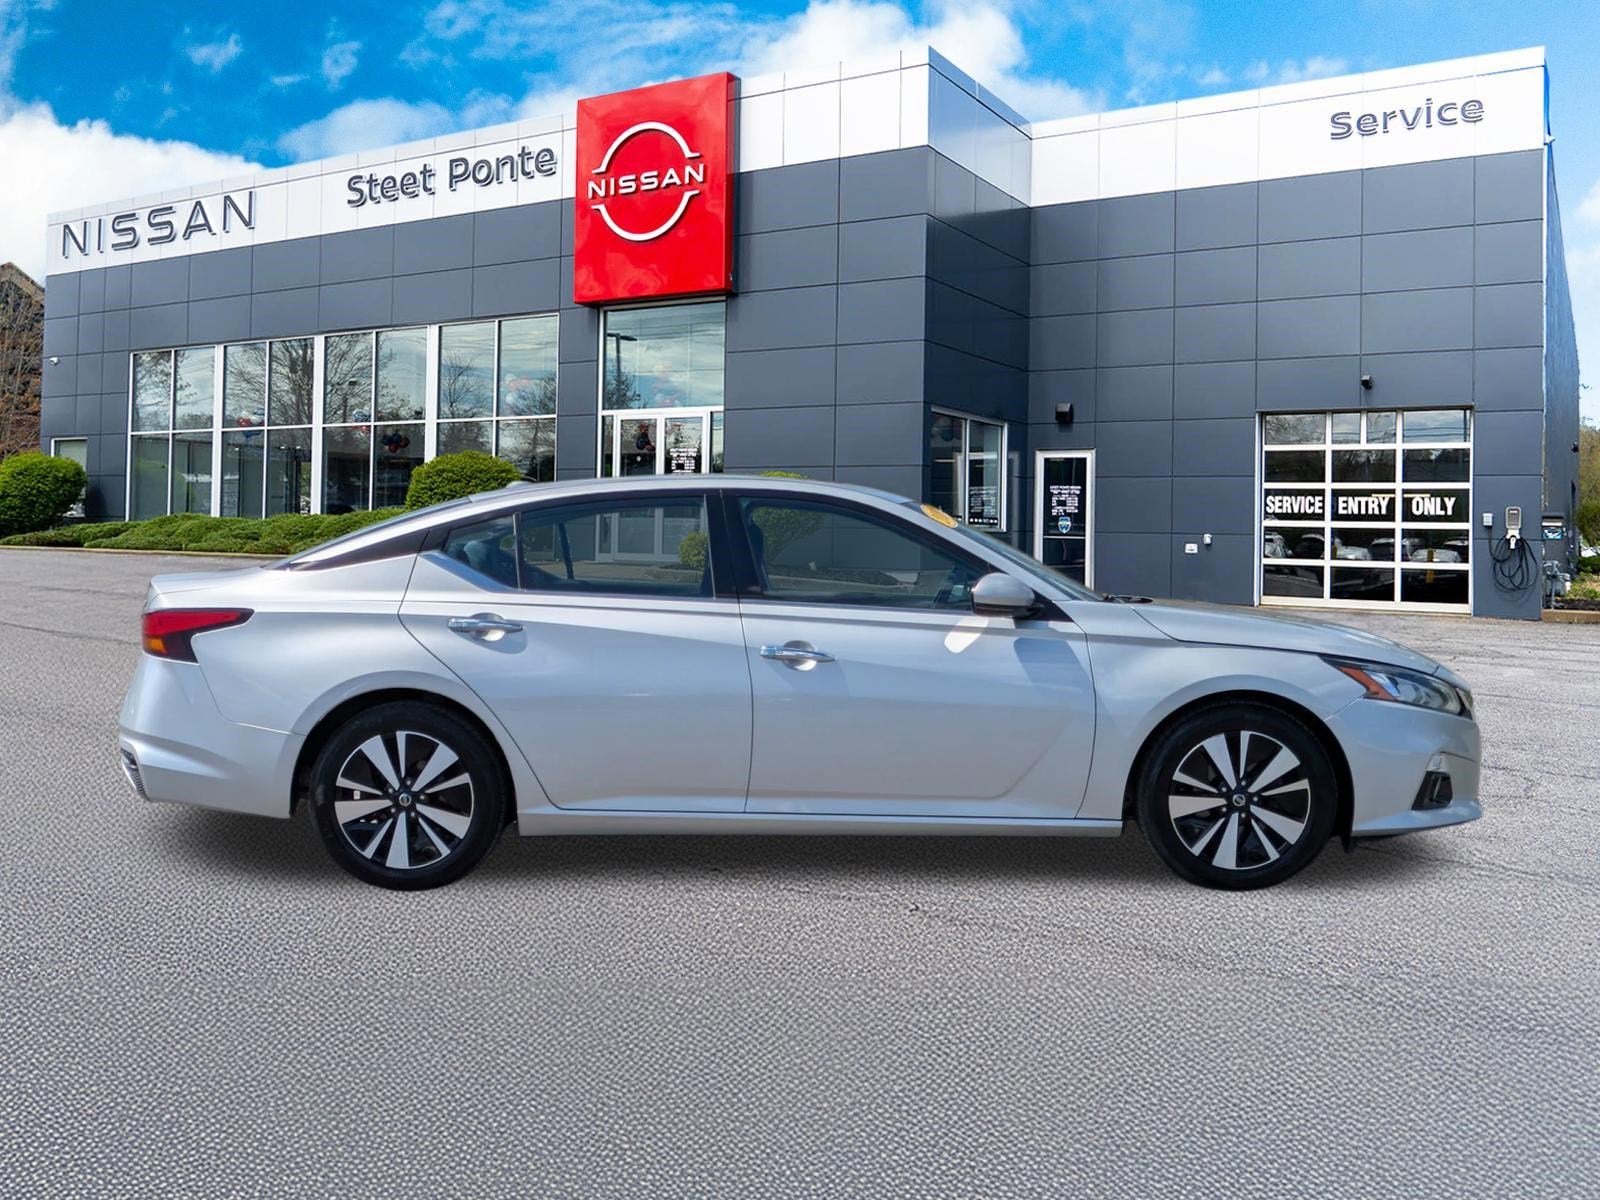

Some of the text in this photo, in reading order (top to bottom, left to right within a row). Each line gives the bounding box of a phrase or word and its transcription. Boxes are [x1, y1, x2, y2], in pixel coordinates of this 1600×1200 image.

[1330, 98, 1484, 140] Service
[347, 146, 557, 207] Steet Ponte
[587, 163, 704, 200] NISSAN
[63, 191, 255, 259] NISSAN
[1265, 496, 1456, 516] SERVICE ENTRY ONLY
